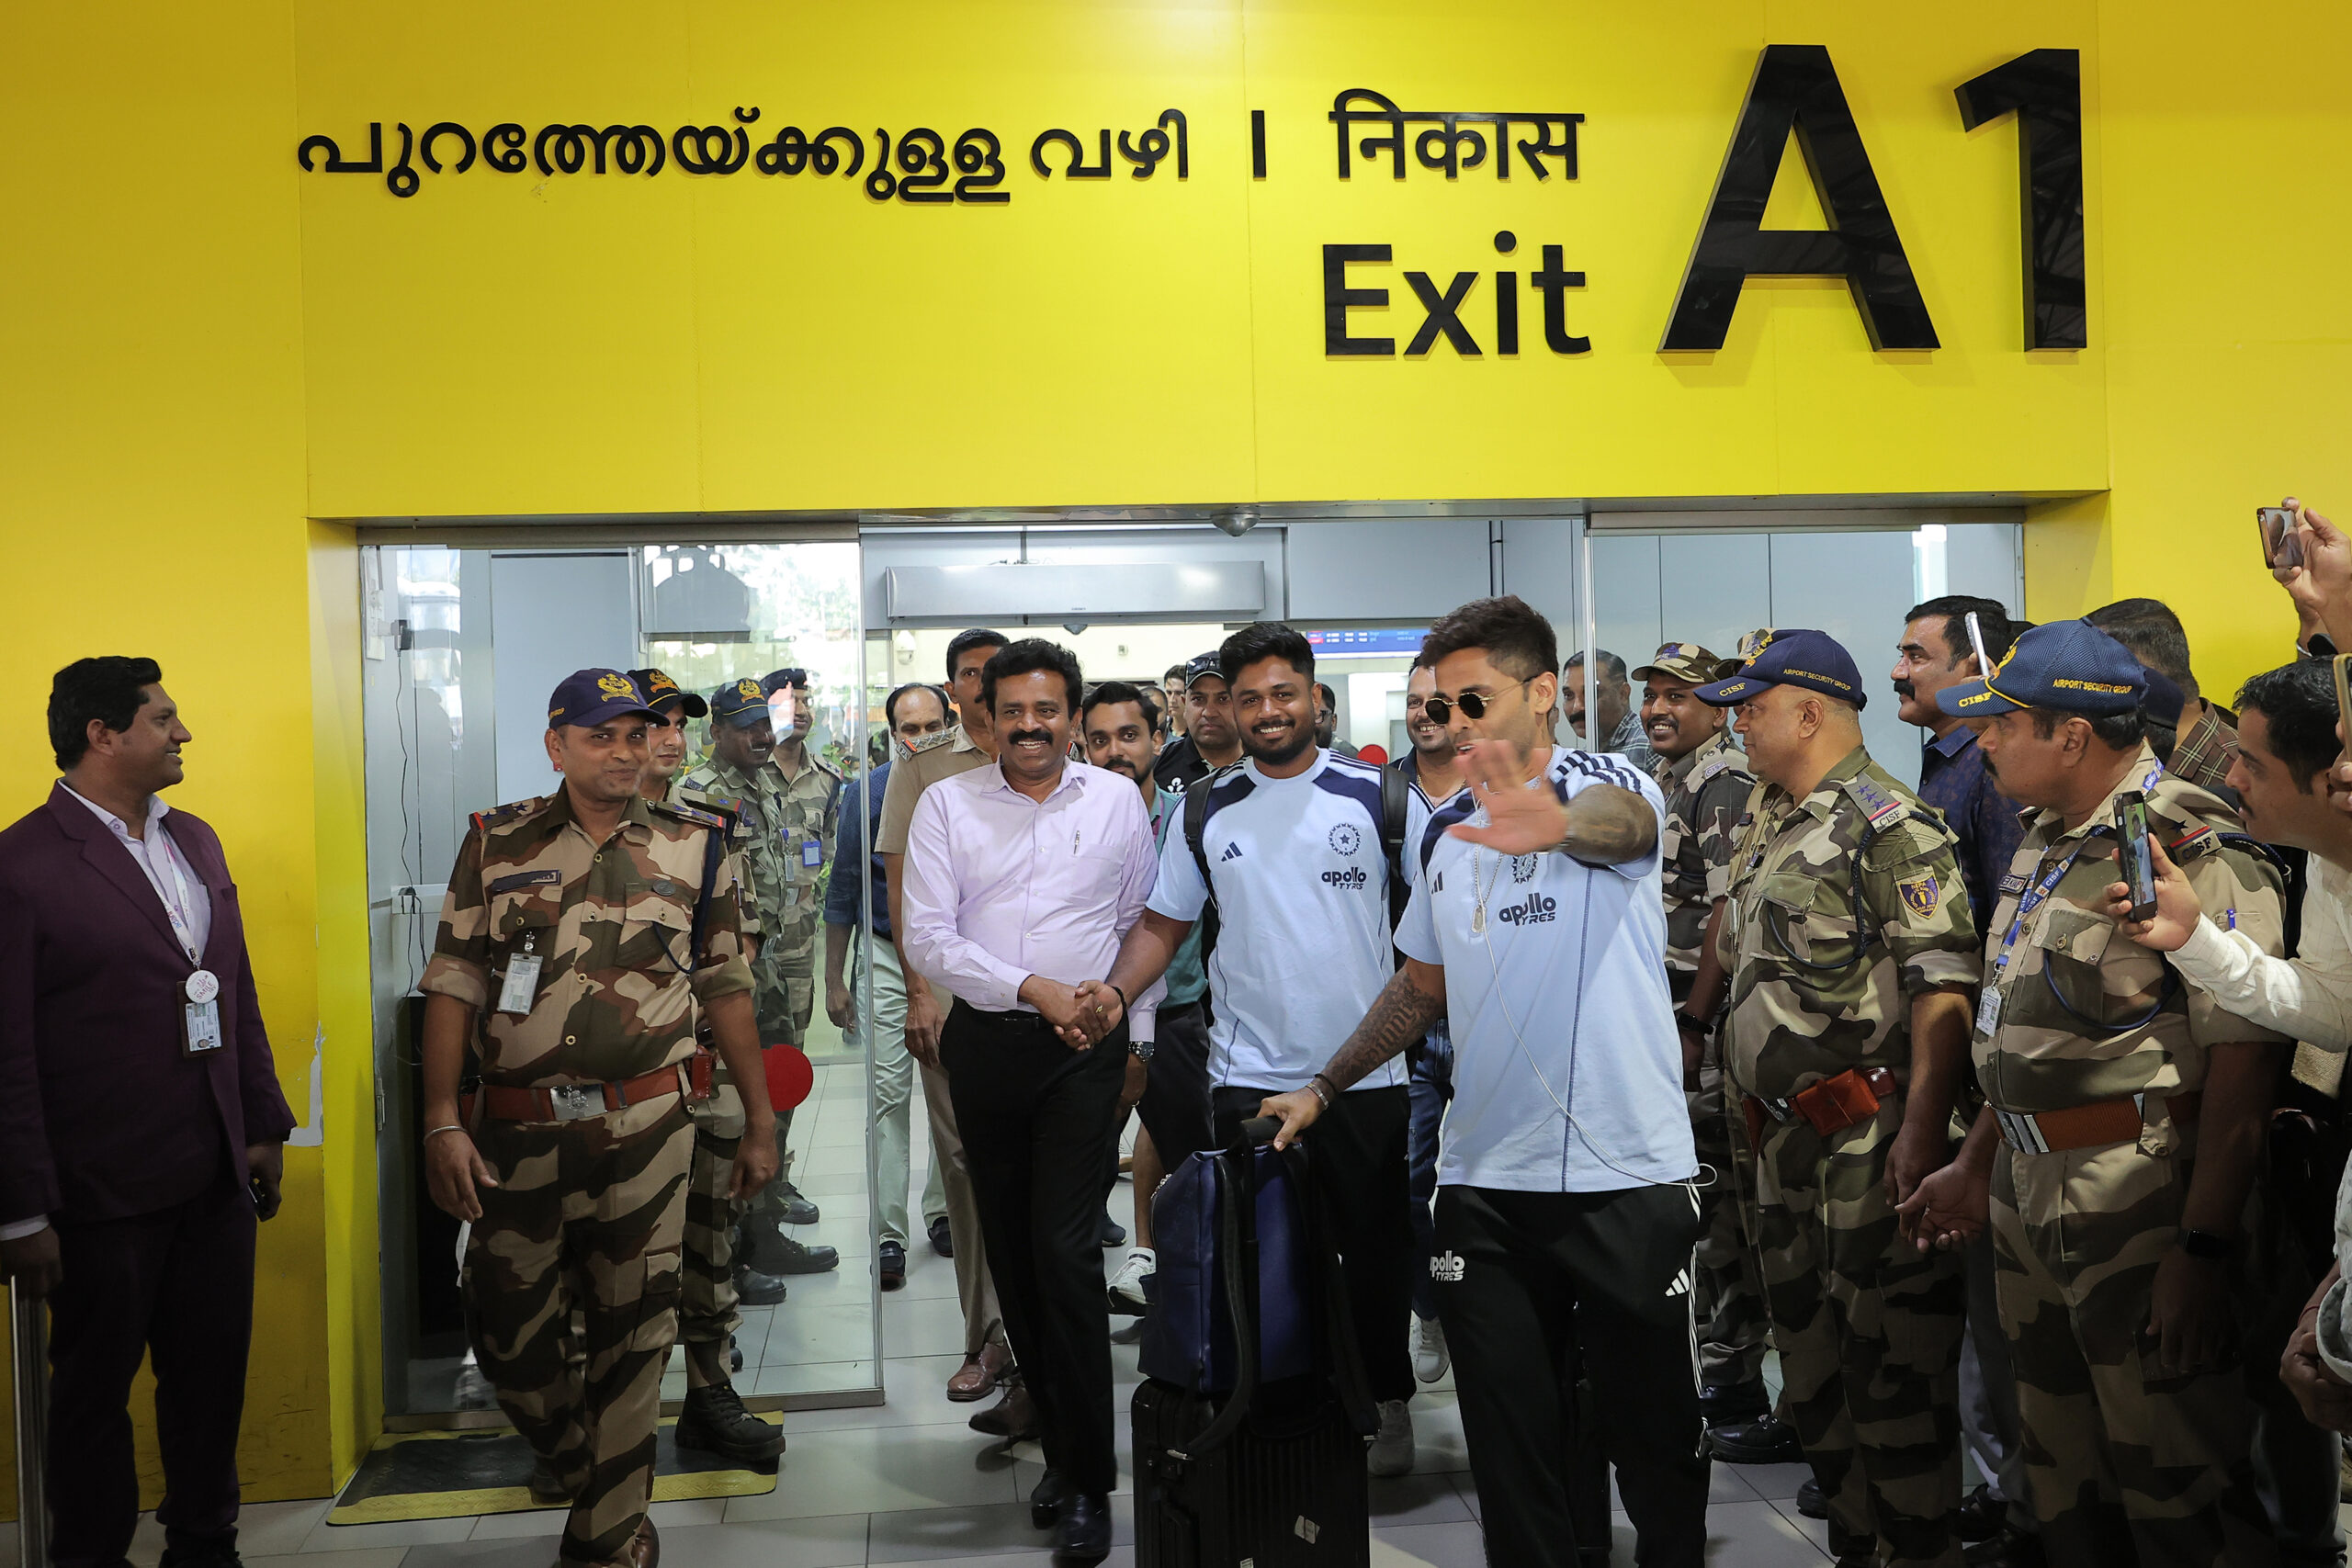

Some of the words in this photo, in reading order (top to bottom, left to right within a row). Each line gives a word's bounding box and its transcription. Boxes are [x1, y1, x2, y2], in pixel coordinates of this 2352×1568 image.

[1030, 108, 1188, 180] വഴി
[1328, 88, 1585, 181] निकास
[1656, 44, 2087, 353] A1
[1322, 230, 1592, 357] Exit
[1719, 682, 1746, 697] CISF
[1783, 668, 1807, 678] AIRPORT
[1807, 671, 1835, 685] SECURITY
[1834, 680, 1851, 692] GROUP
[2052, 679, 2084, 689] AIRPORT
[2083, 682, 2113, 693] SECURITY
[2113, 685, 2132, 694] GROUP
[1958, 692, 1992, 707] CISF
[1879, 810, 1901, 826] CISF
[1321, 867, 1366, 886] apollo
[2045, 870, 2060, 886] CISF
[2026, 896, 2039, 911] CISF
[1521, 912, 1555, 925] YRES
[196, 980, 214, 1000] SMILE
[1430, 1250, 1465, 1278] pollo
